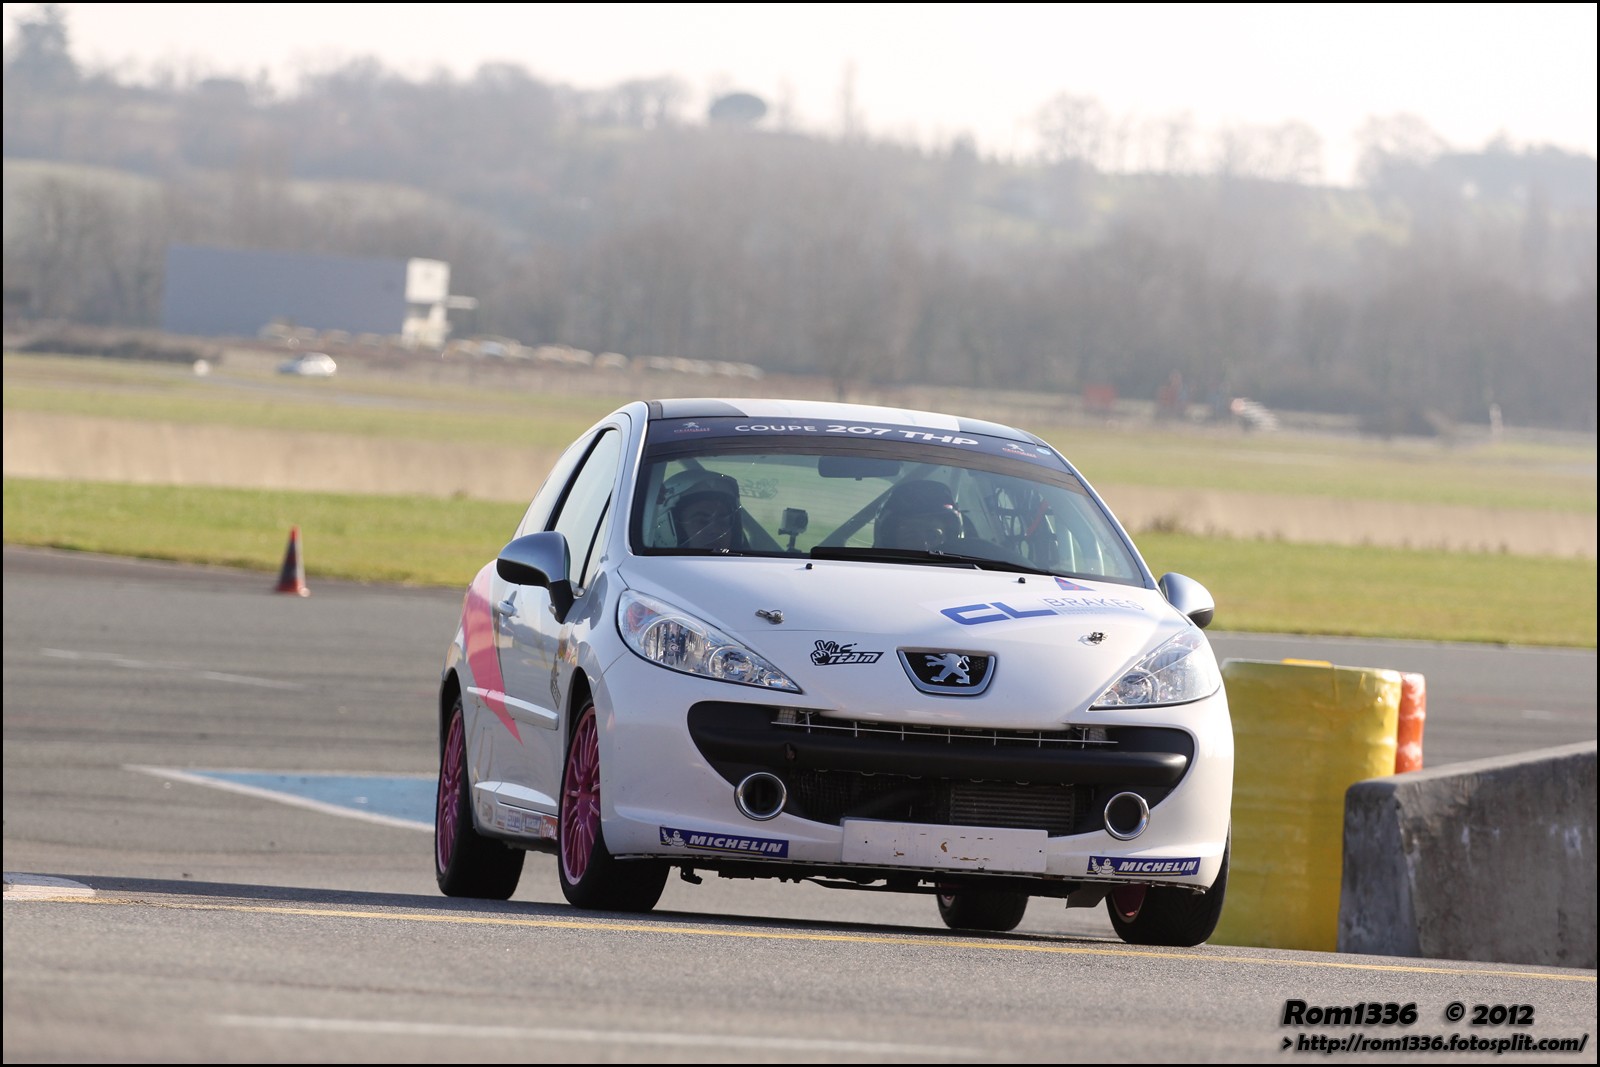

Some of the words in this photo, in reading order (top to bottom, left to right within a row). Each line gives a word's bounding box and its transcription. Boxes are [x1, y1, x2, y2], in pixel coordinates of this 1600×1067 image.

[735, 424, 818, 432] COUPE
[825, 424, 893, 435] 207
[898, 430, 979, 446] THP
[940, 602, 1059, 626] CL
[1043, 598, 1145, 611] BRAKES
[689, 834, 783, 853] MICHELIN
[1119, 861, 1197, 872] MICHELIN
